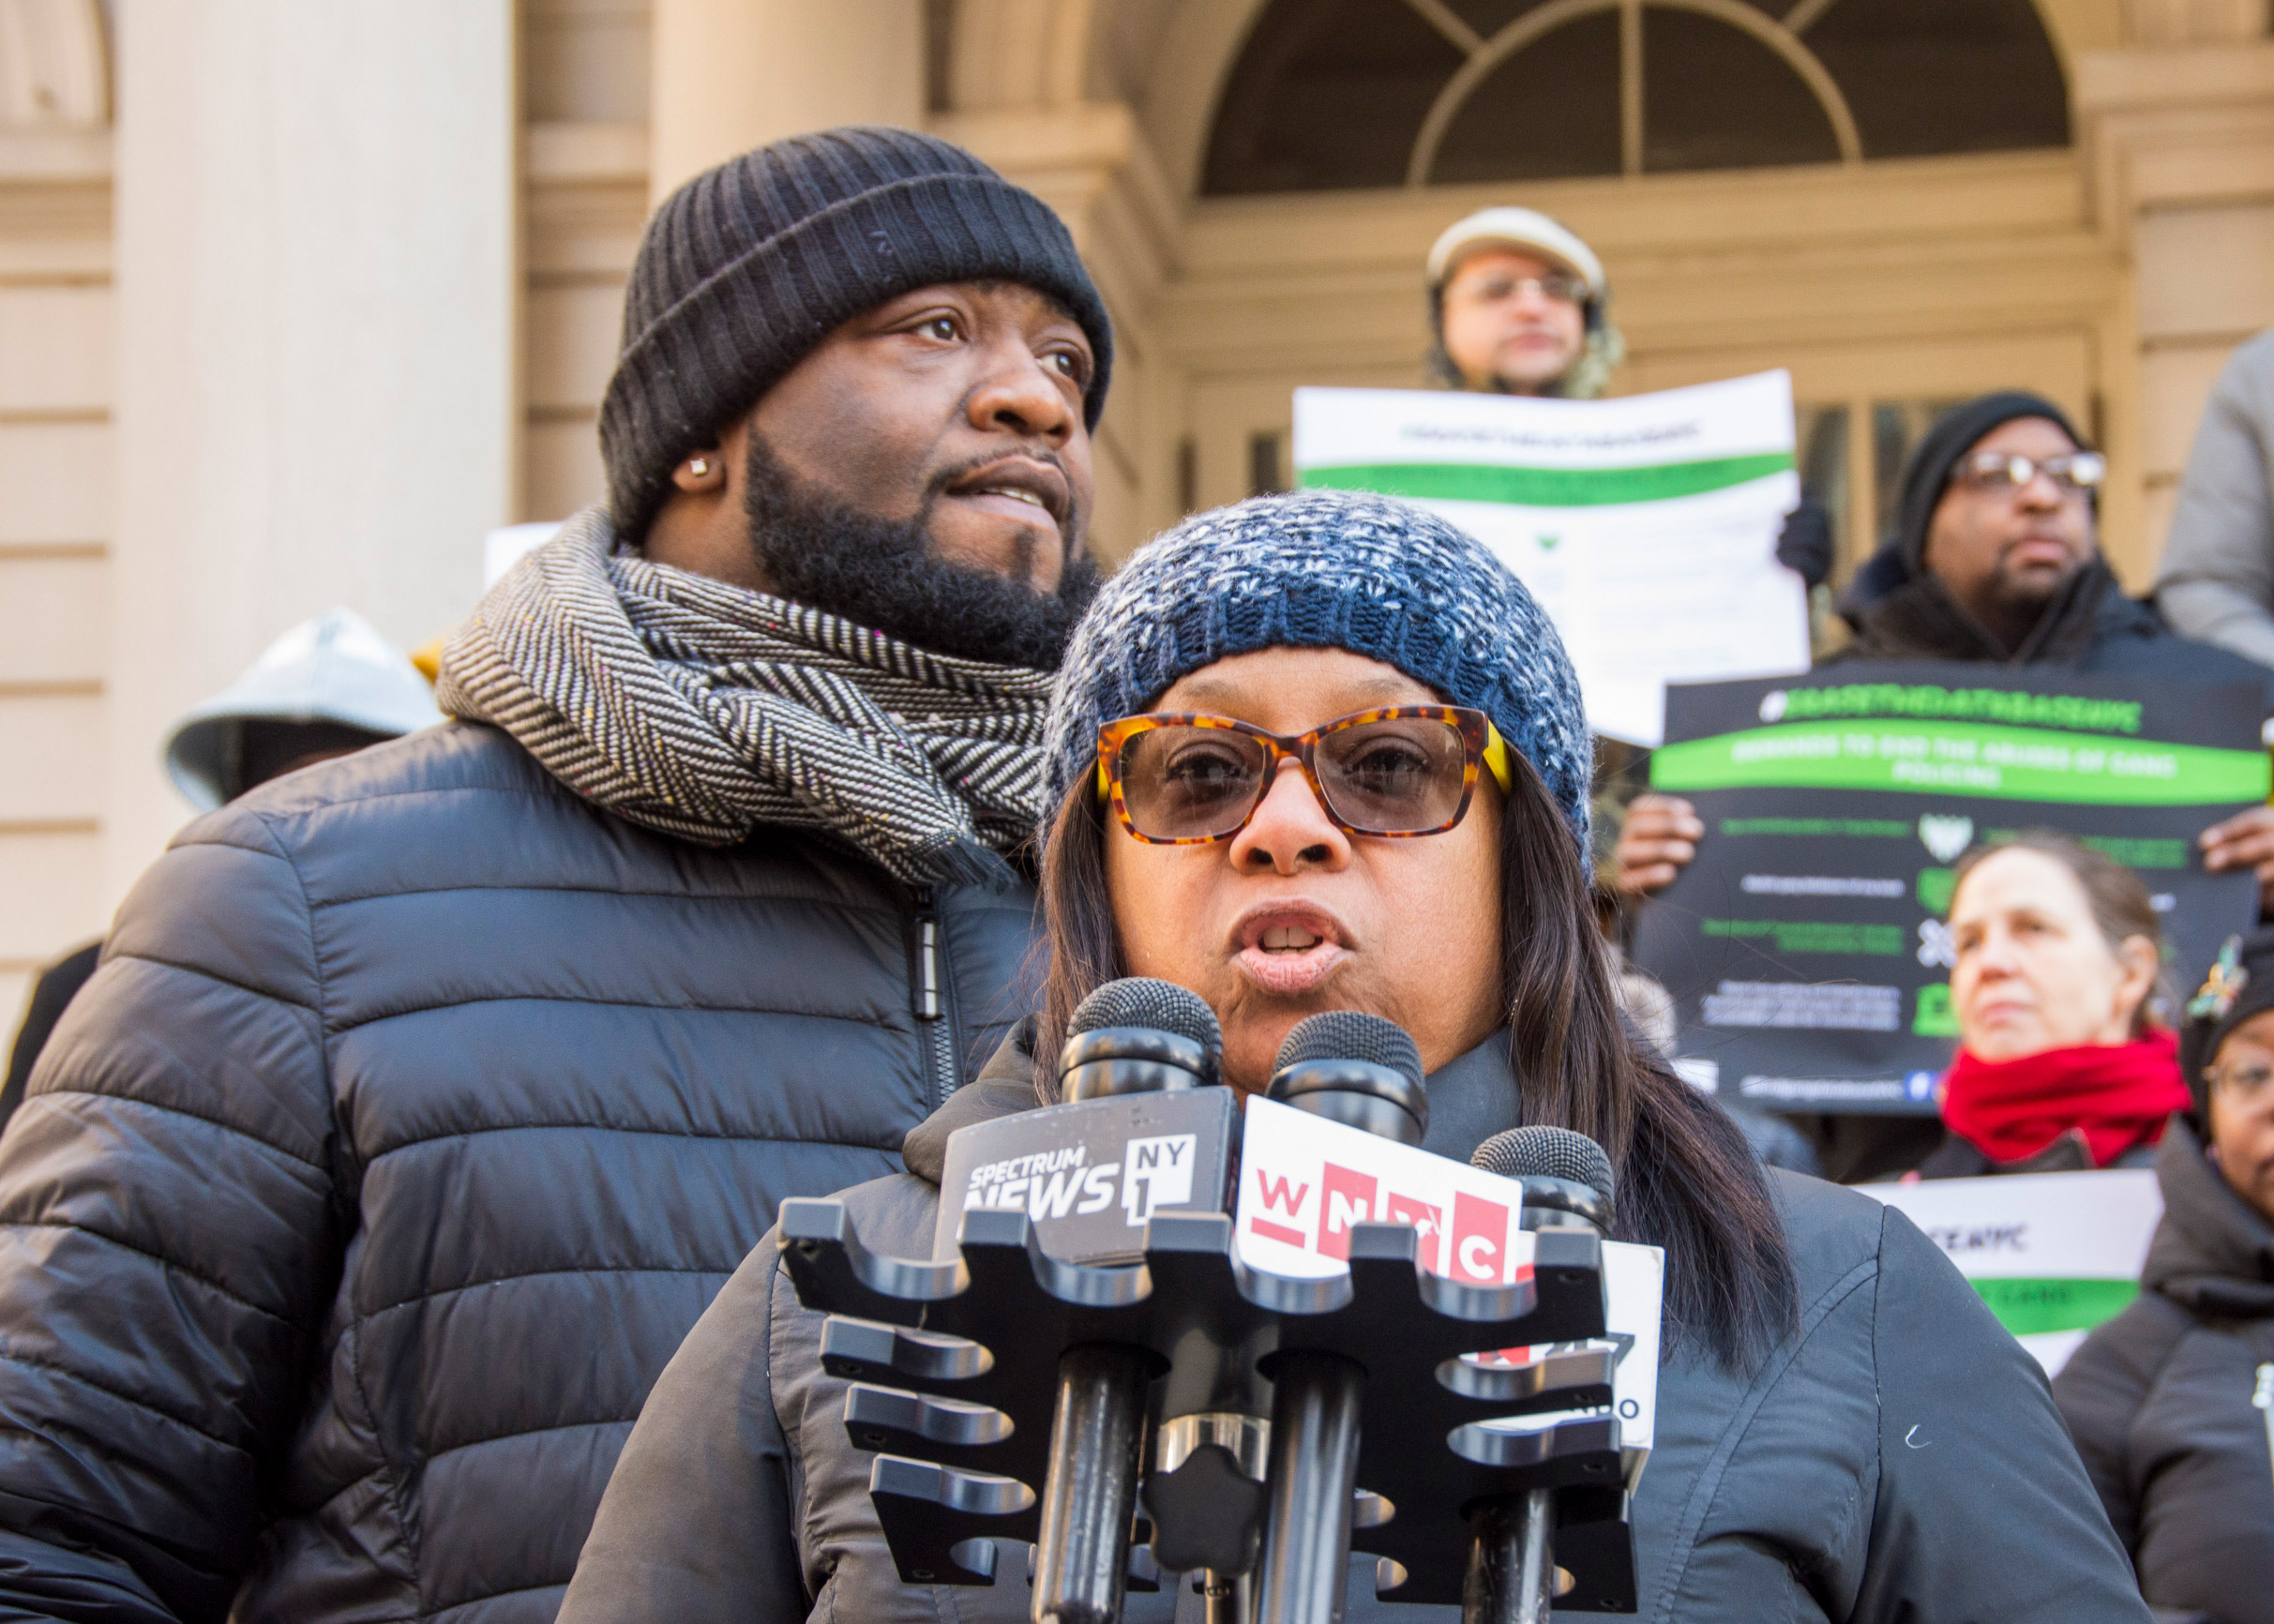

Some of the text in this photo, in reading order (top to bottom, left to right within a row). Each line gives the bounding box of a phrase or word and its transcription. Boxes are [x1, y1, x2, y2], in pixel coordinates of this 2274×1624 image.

[1844, 734, 1876, 758] TO
[1878, 734, 1931, 759] END
[1933, 737, 1979, 761] THE
[2073, 747, 2107, 774] OF
[969, 1146, 1086, 1190] SPECTRUM
[1137, 1141, 1186, 1170] NY
